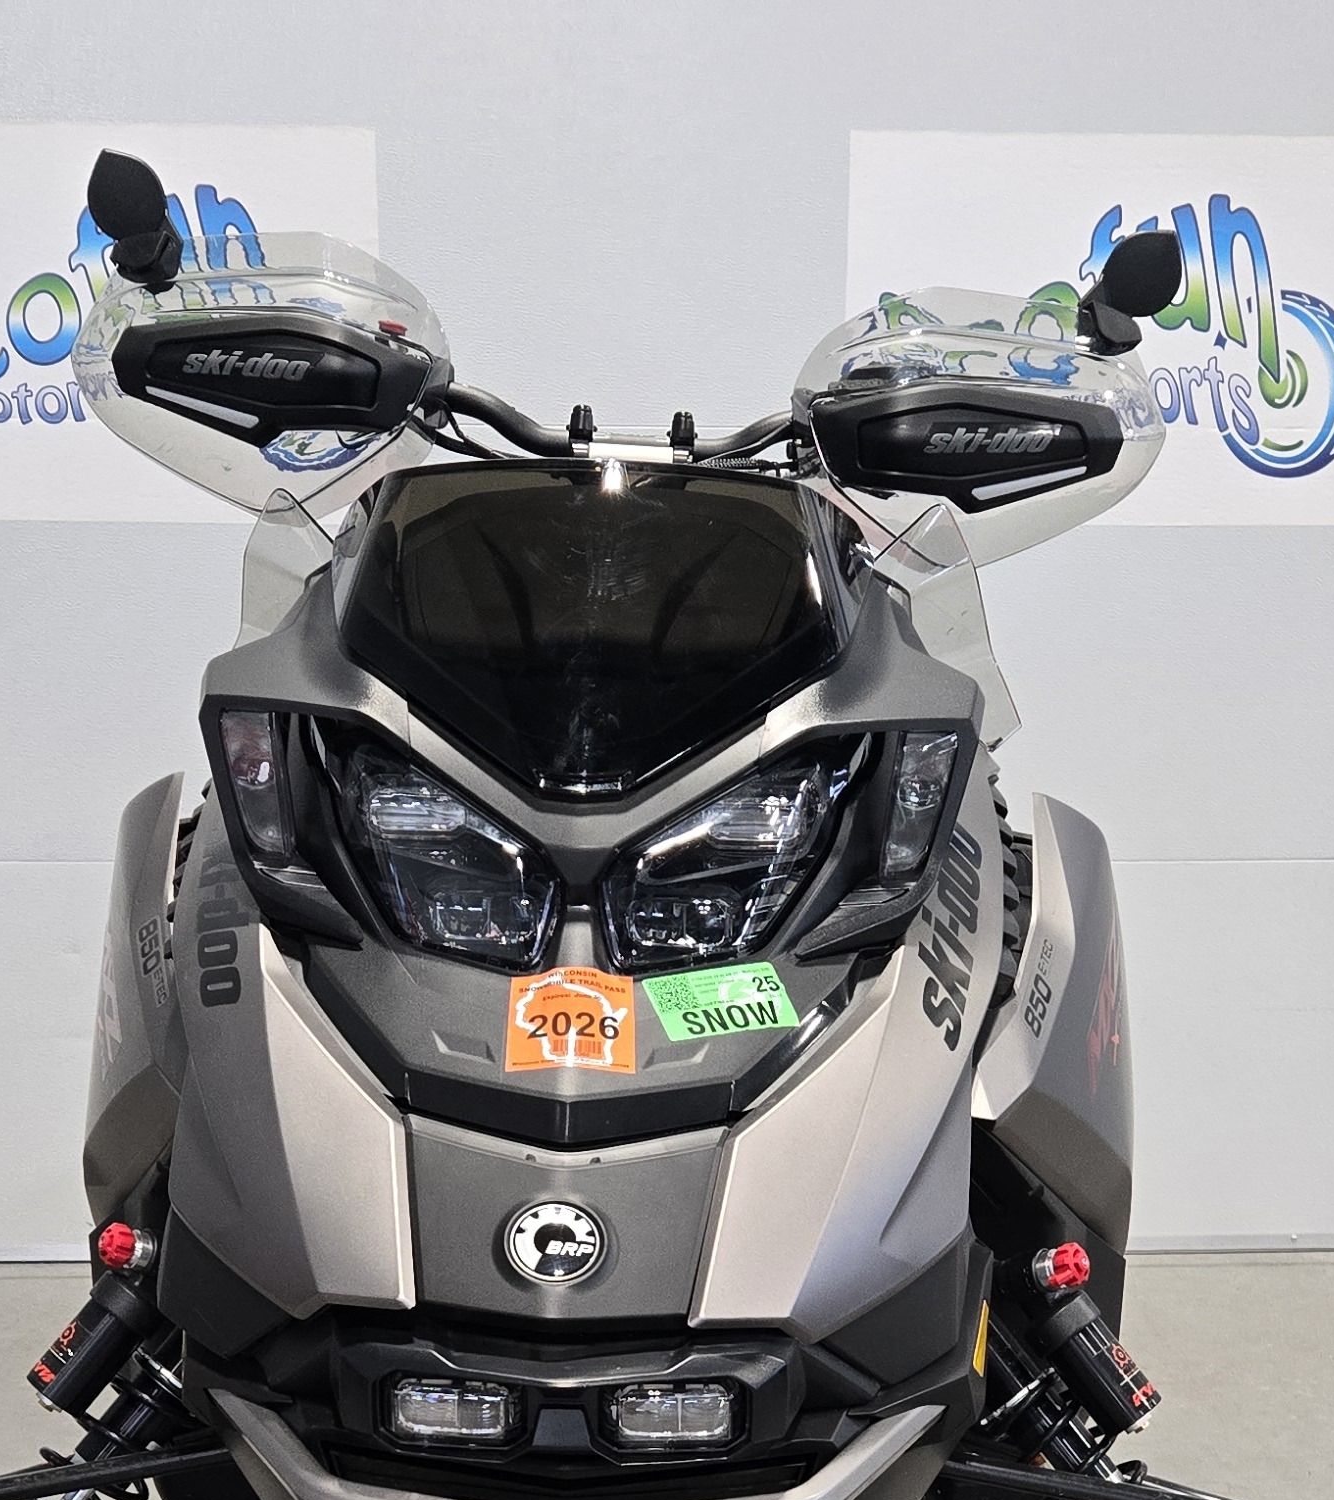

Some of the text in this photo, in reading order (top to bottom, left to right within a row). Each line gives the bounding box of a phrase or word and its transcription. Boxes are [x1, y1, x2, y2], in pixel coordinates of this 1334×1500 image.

[182, 349, 311, 380] ski-doo
[923, 427, 1054, 453] ski-doo
[139, 918, 161, 976] 850
[752, 976, 780, 992] 25
[682, 1000, 779, 1035] SNOW
[1023, 973, 1052, 1039] 850
[527, 1011, 619, 1039] 2026
[545, 1240, 594, 1256] BRP
